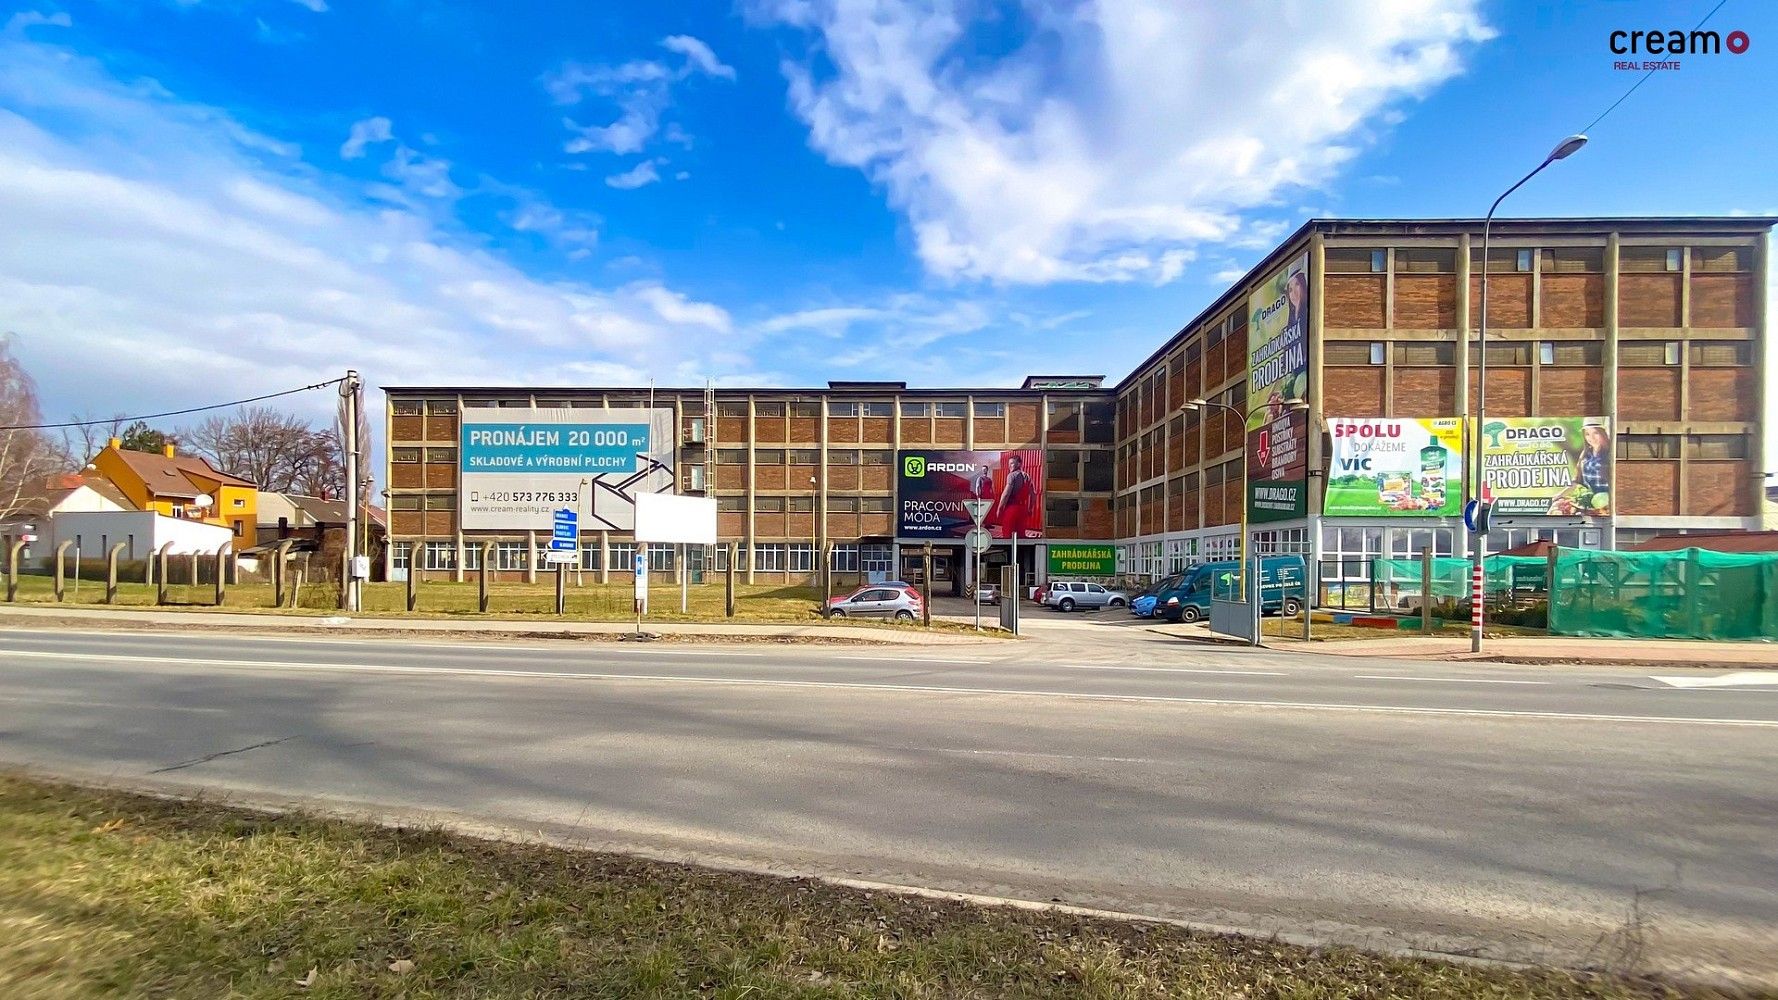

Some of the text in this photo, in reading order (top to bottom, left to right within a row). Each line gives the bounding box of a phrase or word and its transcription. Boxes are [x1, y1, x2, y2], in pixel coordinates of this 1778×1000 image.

[1261, 296, 1286, 320] DRAGO
[1252, 342, 1303, 393] PRODEJNA
[470, 426, 559, 446] PRONÁJEM
[568, 431, 590, 446] 20
[594, 431, 628, 446] 000
[1335, 424, 1401, 438] SPOLU
[1506, 427, 1563, 439] DRAGO
[1354, 440, 1406, 452] DOKÁŽEME
[469, 454, 626, 467] SKLADOVÉ A VÝROBNÍ PLOCHY
[1341, 454, 1372, 471] VÍC
[1485, 449, 1567, 467] ZAHRÁDKÁŘSKÁ
[927, 463, 975, 472] ARDON
[1486, 467, 1572, 489] PRODEJNA
[483, 492, 578, 502] +420 573 776 333
[1255, 487, 1297, 501] WWW.DRAGO.CZ
[1498, 499, 1549, 507] WWW.DRAGO.CZ
[471, 505, 550, 514] www.cream-reality.cz
[904, 511, 940, 523] MÓDA
[1051, 548, 1112, 559] ZAHRÁDKÁŘSKÁ
[1061, 561, 1101, 570] PRODEJNA
